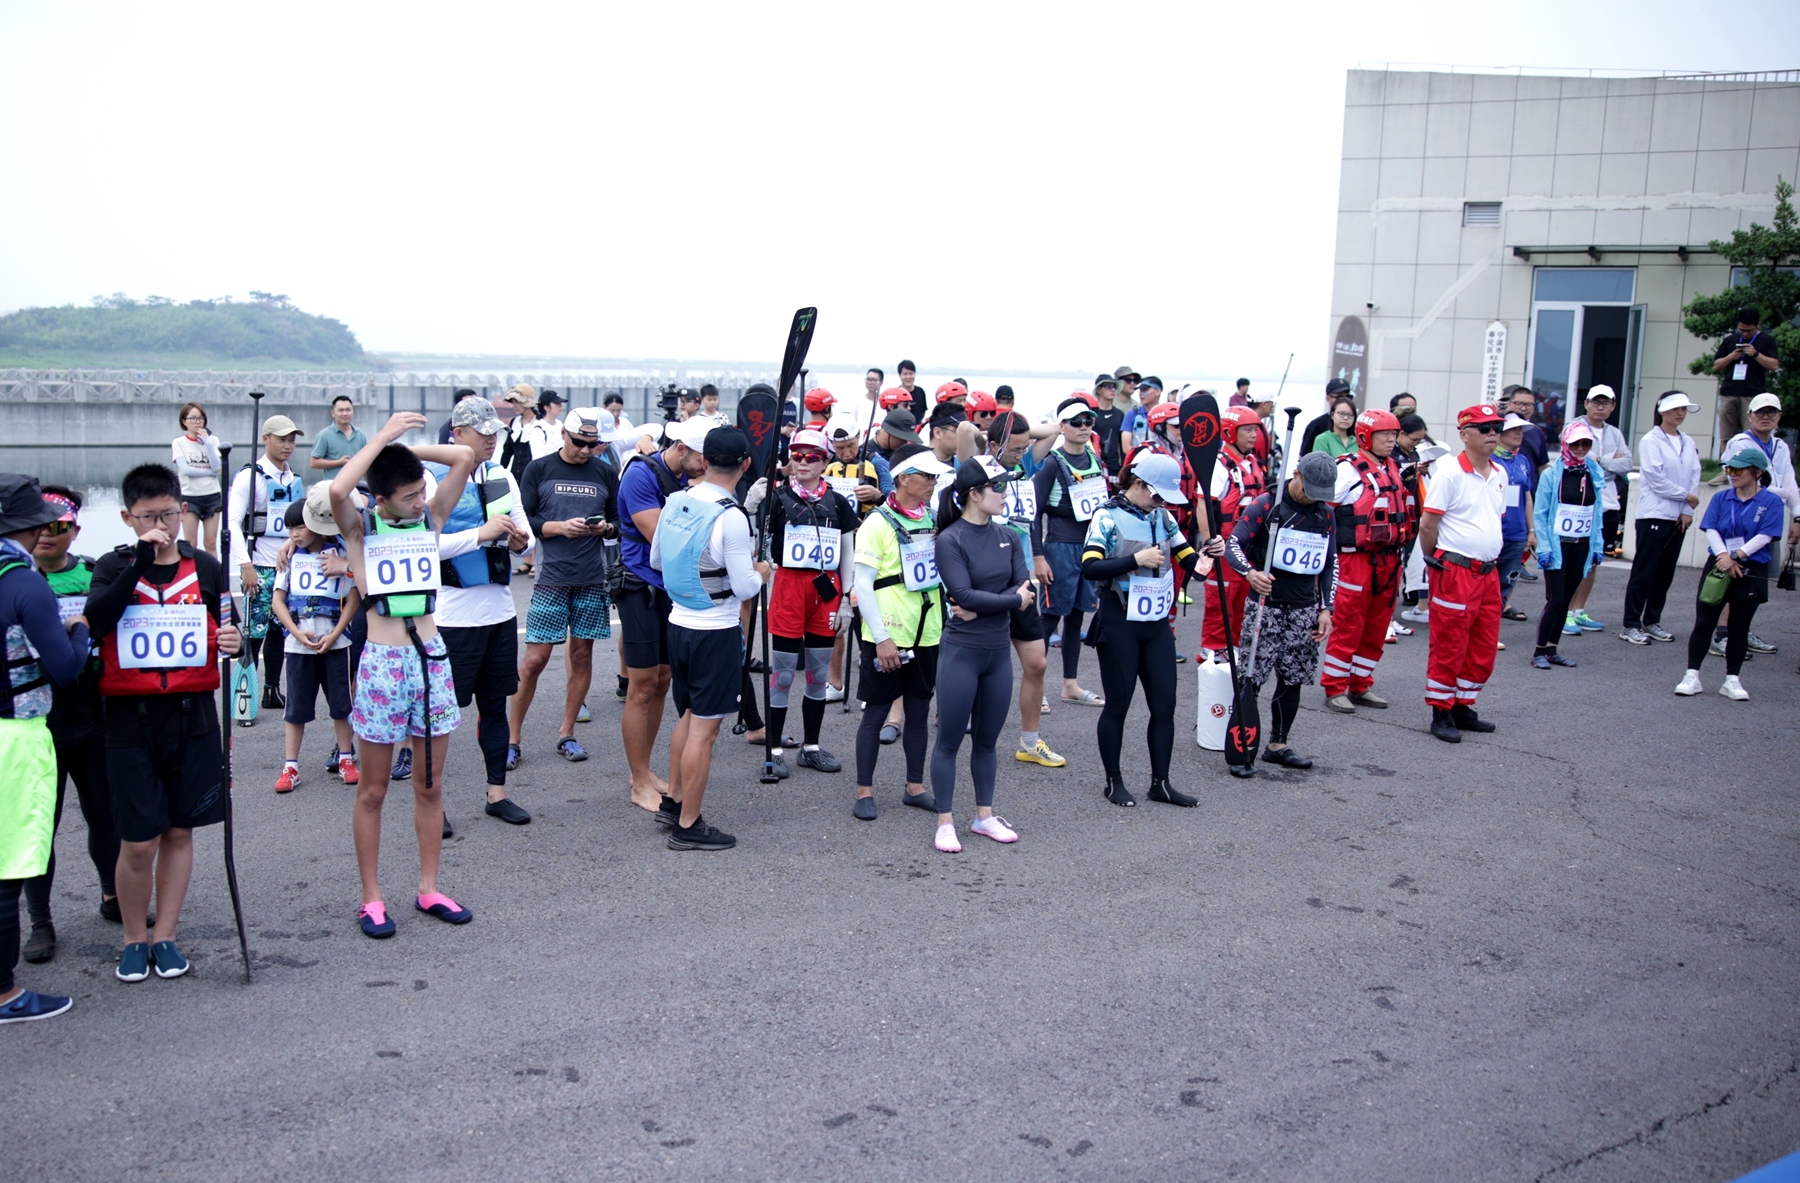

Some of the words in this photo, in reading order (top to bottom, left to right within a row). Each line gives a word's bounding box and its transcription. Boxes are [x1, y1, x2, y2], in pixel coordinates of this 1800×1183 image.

[1561, 518, 1592, 534] 029
[787, 532, 805, 541] 2023
[1280, 536, 1299, 546] 2023
[368, 545, 393, 558] 2023
[791, 543, 835, 565] 049
[905, 551, 924, 562] 2023
[1282, 547, 1322, 570] 046
[294, 561, 313, 569] 2023
[377, 556, 432, 586] 019
[913, 558, 939, 583] 03
[1132, 585, 1154, 594] 2023
[1137, 590, 1173, 616] 039
[123, 617, 149, 629] 2023
[131, 631, 198, 660] 006
